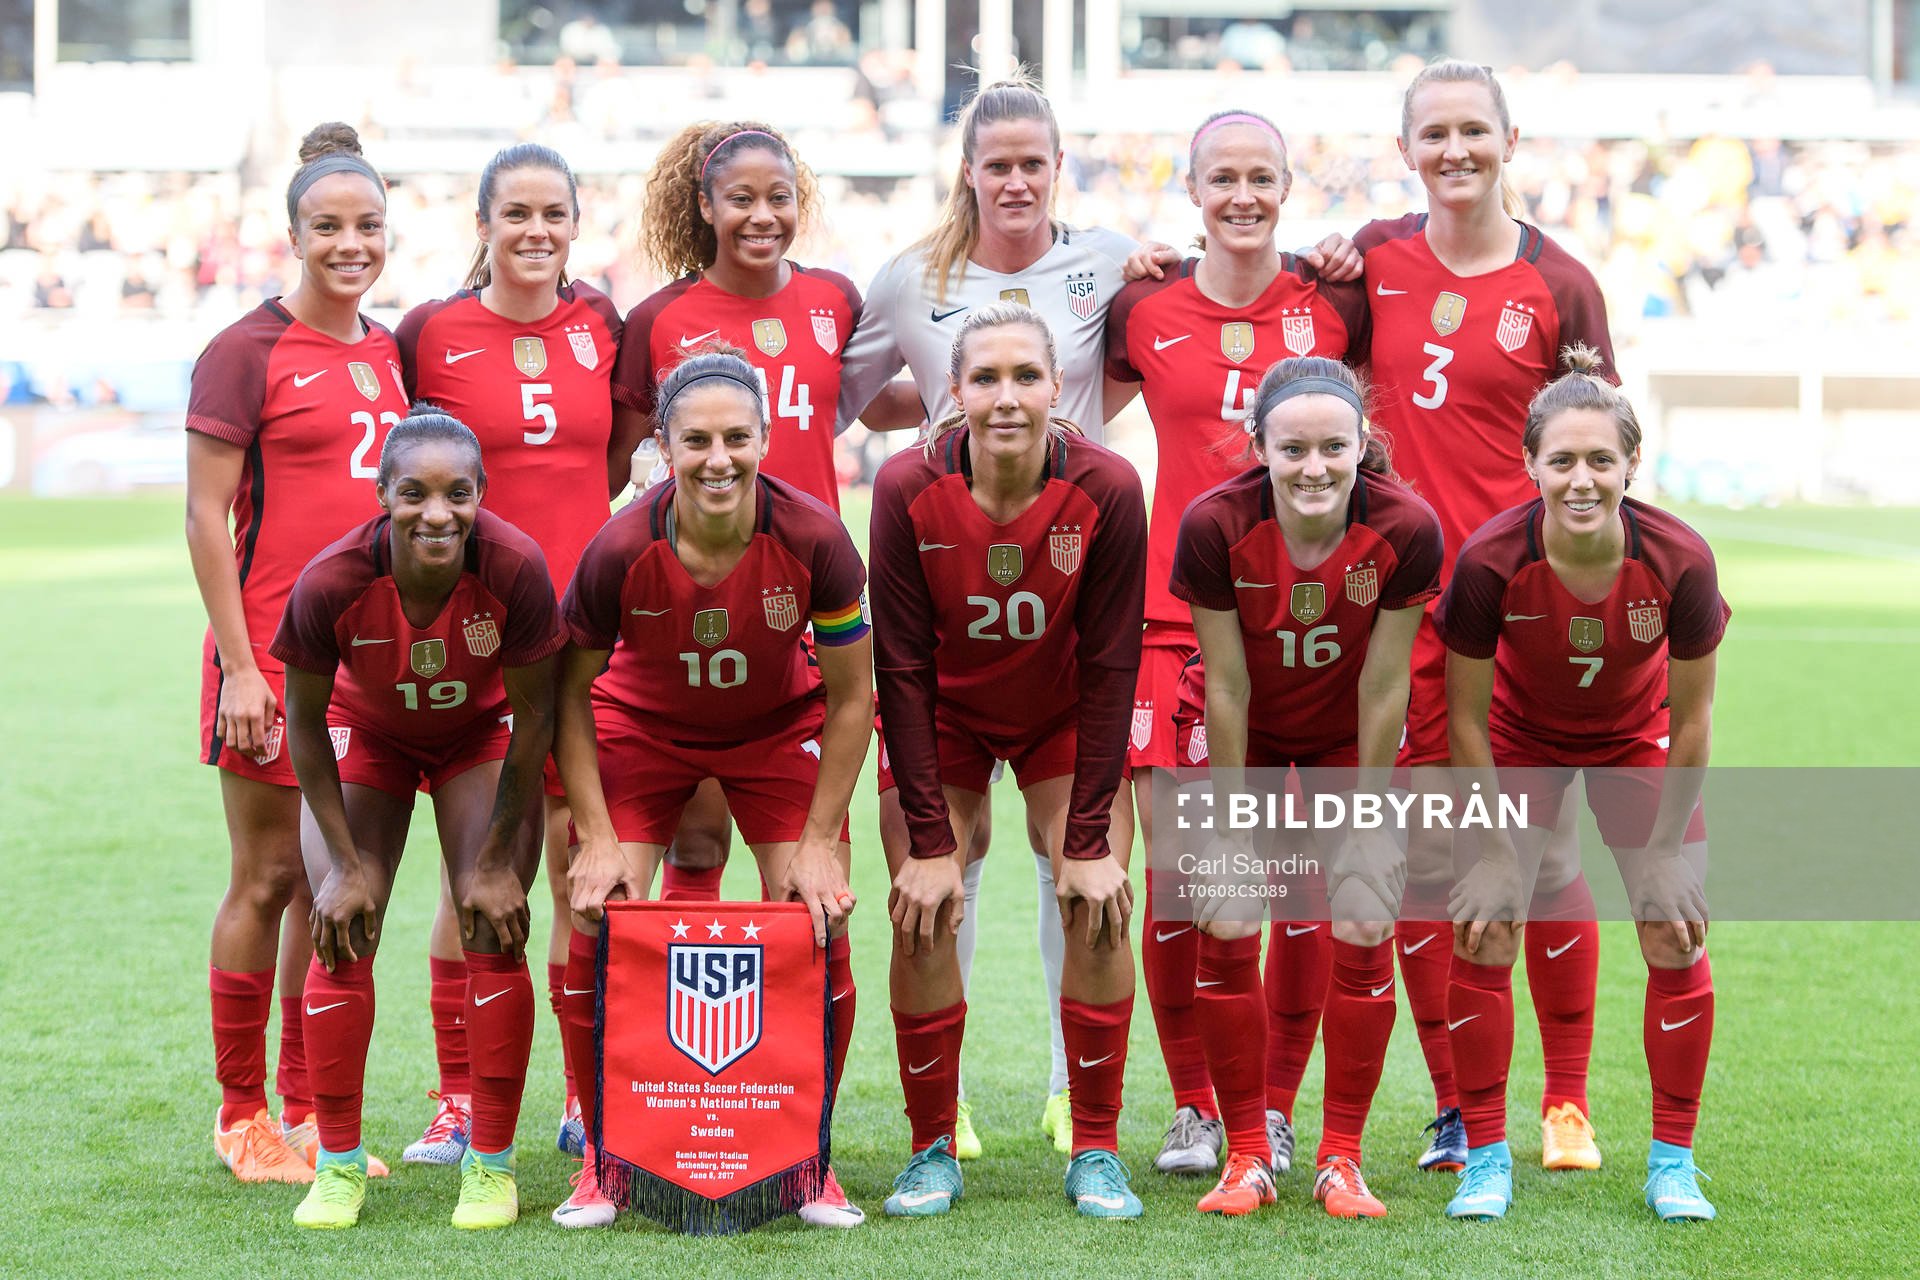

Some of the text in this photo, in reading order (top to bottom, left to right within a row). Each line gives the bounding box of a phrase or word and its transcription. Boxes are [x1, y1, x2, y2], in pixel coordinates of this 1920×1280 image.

[1069, 282, 1094, 297] USA
[813, 319, 833, 333] USA
[1285, 318, 1310, 333] USA
[1503, 311, 1529, 328] USA
[570, 335, 591, 348] USA
[1412, 341, 1454, 410] 3
[1220, 369, 1256, 421] 4
[520, 383, 557, 445] 5
[1053, 536, 1078, 552] USA
[1349, 571, 1375, 586] USA
[766, 596, 794, 612] USA
[967, 591, 1046, 640] 20
[1631, 609, 1658, 624] USA
[467, 622, 495, 638] USA
[1276, 625, 1342, 668] 16
[679, 649, 747, 689] 10
[1568, 656, 1604, 688] 7
[396, 680, 467, 711] 19
[676, 952, 756, 1000] USA
[631, 1081, 794, 1094] United States Soccer Federation
[646, 1096, 780, 1109] Women's National Team
[706, 1113, 719, 1121] vs.
[690, 1126, 734, 1138] Sweden
[720, 1152, 749, 1160] Stadium
[720, 1161, 747, 1170] Sweden
[689, 1170, 707, 1179] June
[718, 1172, 735, 1180] 2017
